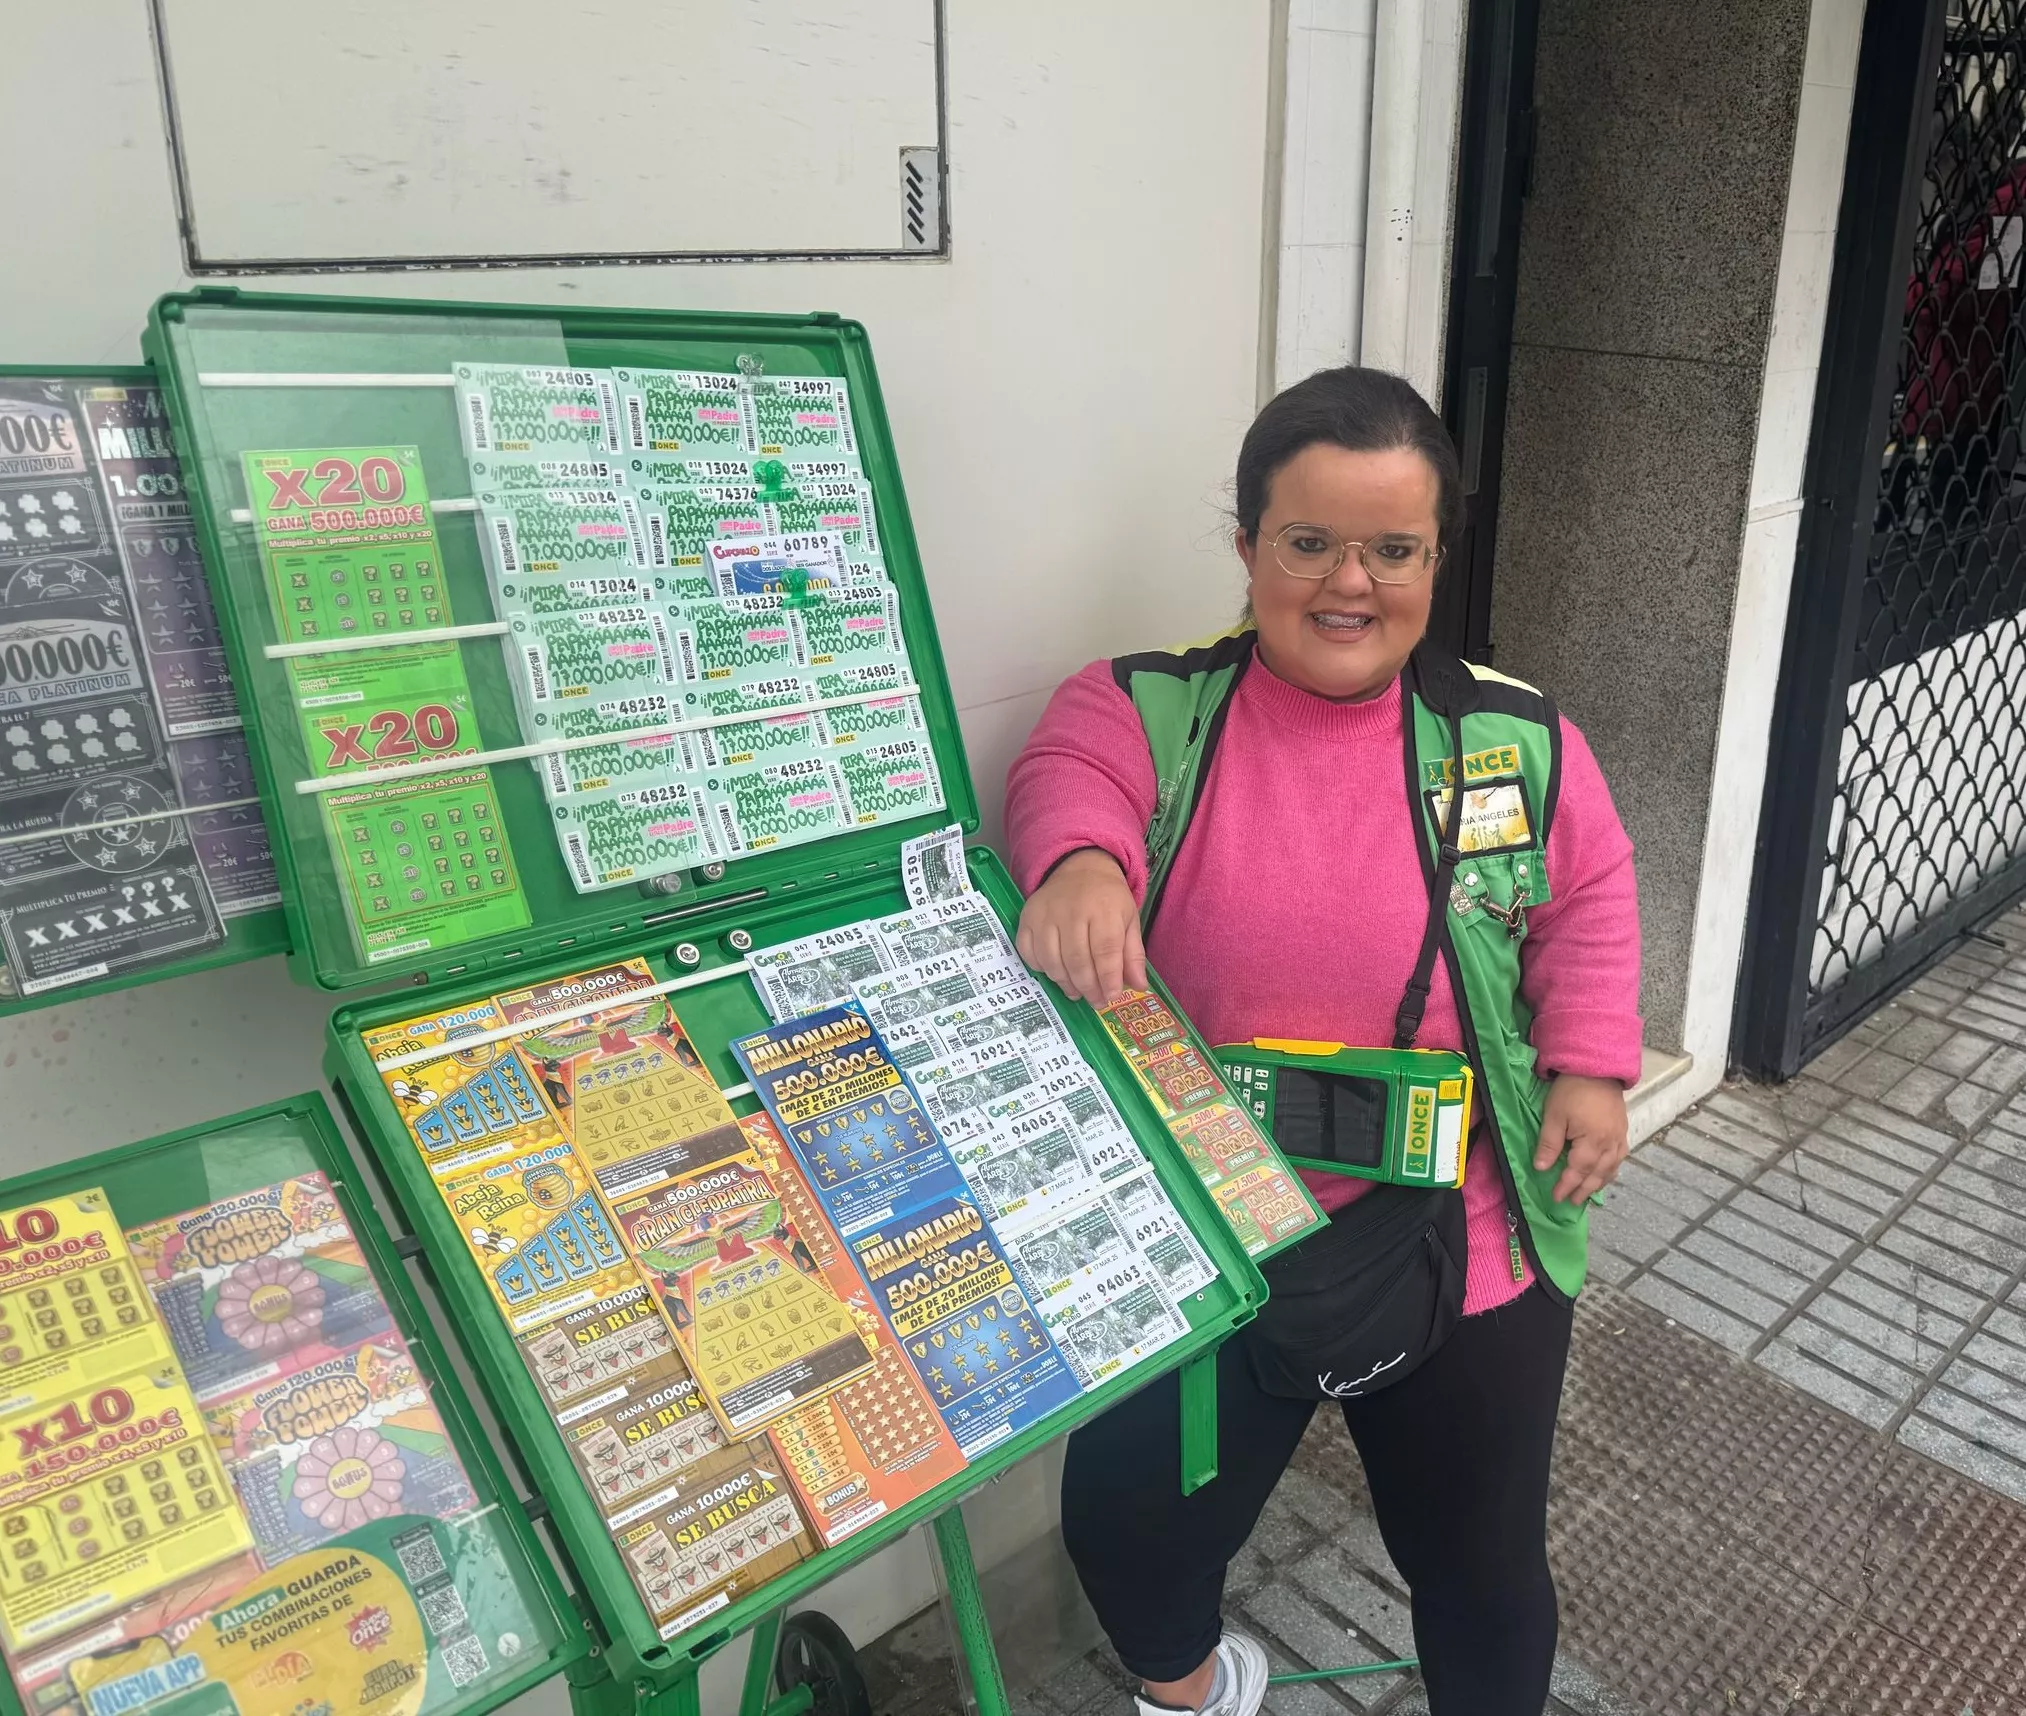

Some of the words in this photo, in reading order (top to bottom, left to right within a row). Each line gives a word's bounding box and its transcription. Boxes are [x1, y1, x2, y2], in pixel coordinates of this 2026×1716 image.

[696, 376, 736, 390] 13024
[794, 382, 831, 394] 34997
[712, 411, 738, 420] Padre
[810, 415, 835, 424] Padre
[706, 462, 748, 475] 13024
[808, 463, 846, 476] 34997
[717, 488, 757, 500] 74376
[818, 484, 856, 496] 13024
[268, 518, 305, 531] GANA
[310, 505, 425, 532] 500.000€
[784, 536, 828, 552] 60789
[533, 563, 558, 571] ONCE
[744, 596, 783, 610] 48232
[844, 587, 882, 600] 24805
[760, 630, 786, 640] Padre
[709, 670, 731, 678] ONCE
[859, 664, 896, 679] 24805
[28, 674, 130, 700] PLATINUM
[563, 687, 588, 697] ONCE
[758, 678, 800, 695] 48232
[601, 703, 616, 711] 074
[731, 754, 752, 762] ONCE
[880, 741, 916, 758] 24805
[780, 759, 824, 777] 48232
[328, 791, 372, 806] Multiplica
[375, 790, 385, 799] tu
[387, 784, 418, 797] premio
[449, 776, 463, 785] x10
[472, 773, 486, 781] x20
[583, 779, 608, 789] ONCE
[621, 794, 636, 802] 075
[1479, 808, 1519, 822] ANGELES
[754, 836, 777, 846] ONCE
[608, 869, 633, 880] ONCE
[907, 855, 926, 906] 86130
[915, 913, 927, 921] 027
[933, 900, 976, 919] 76921
[816, 928, 863, 950] 24085
[633, 962, 643, 970] 5€
[915, 957, 960, 979] 76921
[532, 997, 551, 1007] GANA
[550, 973, 626, 1000] 500.000€
[970, 1003, 982, 1011] 012
[987, 985, 1030, 1008] 86130
[409, 1023, 435, 1035] GANA
[438, 1006, 496, 1029] 120.000
[747, 1014, 871, 1075] MILLONARIO
[1148, 1031, 1173, 1043] PREMIO
[807, 1053, 837, 1067] GANA
[971, 1040, 1014, 1064] 76921
[773, 1047, 885, 1100] 500.000€
[813, 1093, 825, 1103] DE
[827, 1086, 842, 1097] 20
[845, 1067, 894, 1091] MILLONES
[797, 1107, 810, 1118] DE
[813, 1104, 821, 1112] €
[824, 1098, 837, 1108] EN
[839, 1078, 889, 1103] PREMIOS!
[1184, 1088, 1210, 1104] PREMIO
[491, 1119, 513, 1129] PREMIO
[993, 1134, 1005, 1143] 043
[1012, 1111, 1057, 1139] 94063
[1189, 1107, 1217, 1126] 7.500€
[1411, 1094, 1429, 1149] ONCE
[486, 1164, 512, 1180] GANA
[515, 1144, 572, 1170] 120.000
[746, 1156, 756, 1165] 5€
[974, 1152, 994, 1164] DIARIO
[1229, 1150, 1256, 1167] PREMIO
[308, 1175, 321, 1184] 2€
[1222, 1186, 1236, 1197] Gana
[1234, 1172, 1263, 1191] 7.500€
[85, 1193, 101, 1203] 2€
[455, 1184, 500, 1214] Abeja
[648, 1202, 668, 1214] GANA
[667, 1169, 739, 1203] 500.000€
[480, 1193, 525, 1221] Reina
[633, 1209, 683, 1251] GRAN
[680, 1176, 775, 1224] CLEOPATRA
[191, 1208, 288, 1248] FLOWER
[1276, 1215, 1302, 1233] PREMIO
[200, 1227, 289, 1265] POWER
[861, 1206, 984, 1282] MILLONARIO
[920, 1251, 950, 1268] GANA
[887, 1241, 996, 1310] 500.000€
[1079, 1293, 1092, 1303] 045
[1097, 1265, 1141, 1296] 94063
[927, 1300, 939, 1312] DE
[940, 1289, 956, 1302] 20
[958, 1264, 1006, 1296] MILLONES
[253, 1294, 288, 1315] BONUS
[910, 1317, 924, 1328] DE
[927, 1311, 935, 1320] €
[936, 1304, 950, 1316] EN
[952, 1277, 1001, 1309] PREMIOS!
[566, 1310, 595, 1326] GANA
[1062, 1313, 1081, 1326] DIARIO
[575, 1326, 606, 1347] SE
[265, 1376, 364, 1426] FLOWER
[278, 1393, 368, 1442] POWER
[616, 1404, 645, 1422] GANA
[625, 1419, 656, 1445] SE
[25, 1408, 183, 1481] 150.000€
[766, 1460, 775, 1469] 1€
[331, 1467, 368, 1490] BONUS
[826, 1484, 856, 1506] BONUS
[630, 1523, 654, 1540] ONCE
[666, 1505, 696, 1525] GANA
[696, 1472, 752, 1510] 10.000€
[675, 1522, 706, 1549] SE
[705, 1479, 777, 1530] BUSCA
[220, 1593, 279, 1630] Ahora
[287, 1555, 361, 1597] GUARDA
[216, 1627, 248, 1649] TUS
[250, 1567, 372, 1632] COMBINACIONES
[250, 1606, 329, 1652] FAVORITAS
[332, 1594, 354, 1611] DE
[91, 1670, 166, 1716] NUEVA
[164, 1654, 200, 1688] APP
